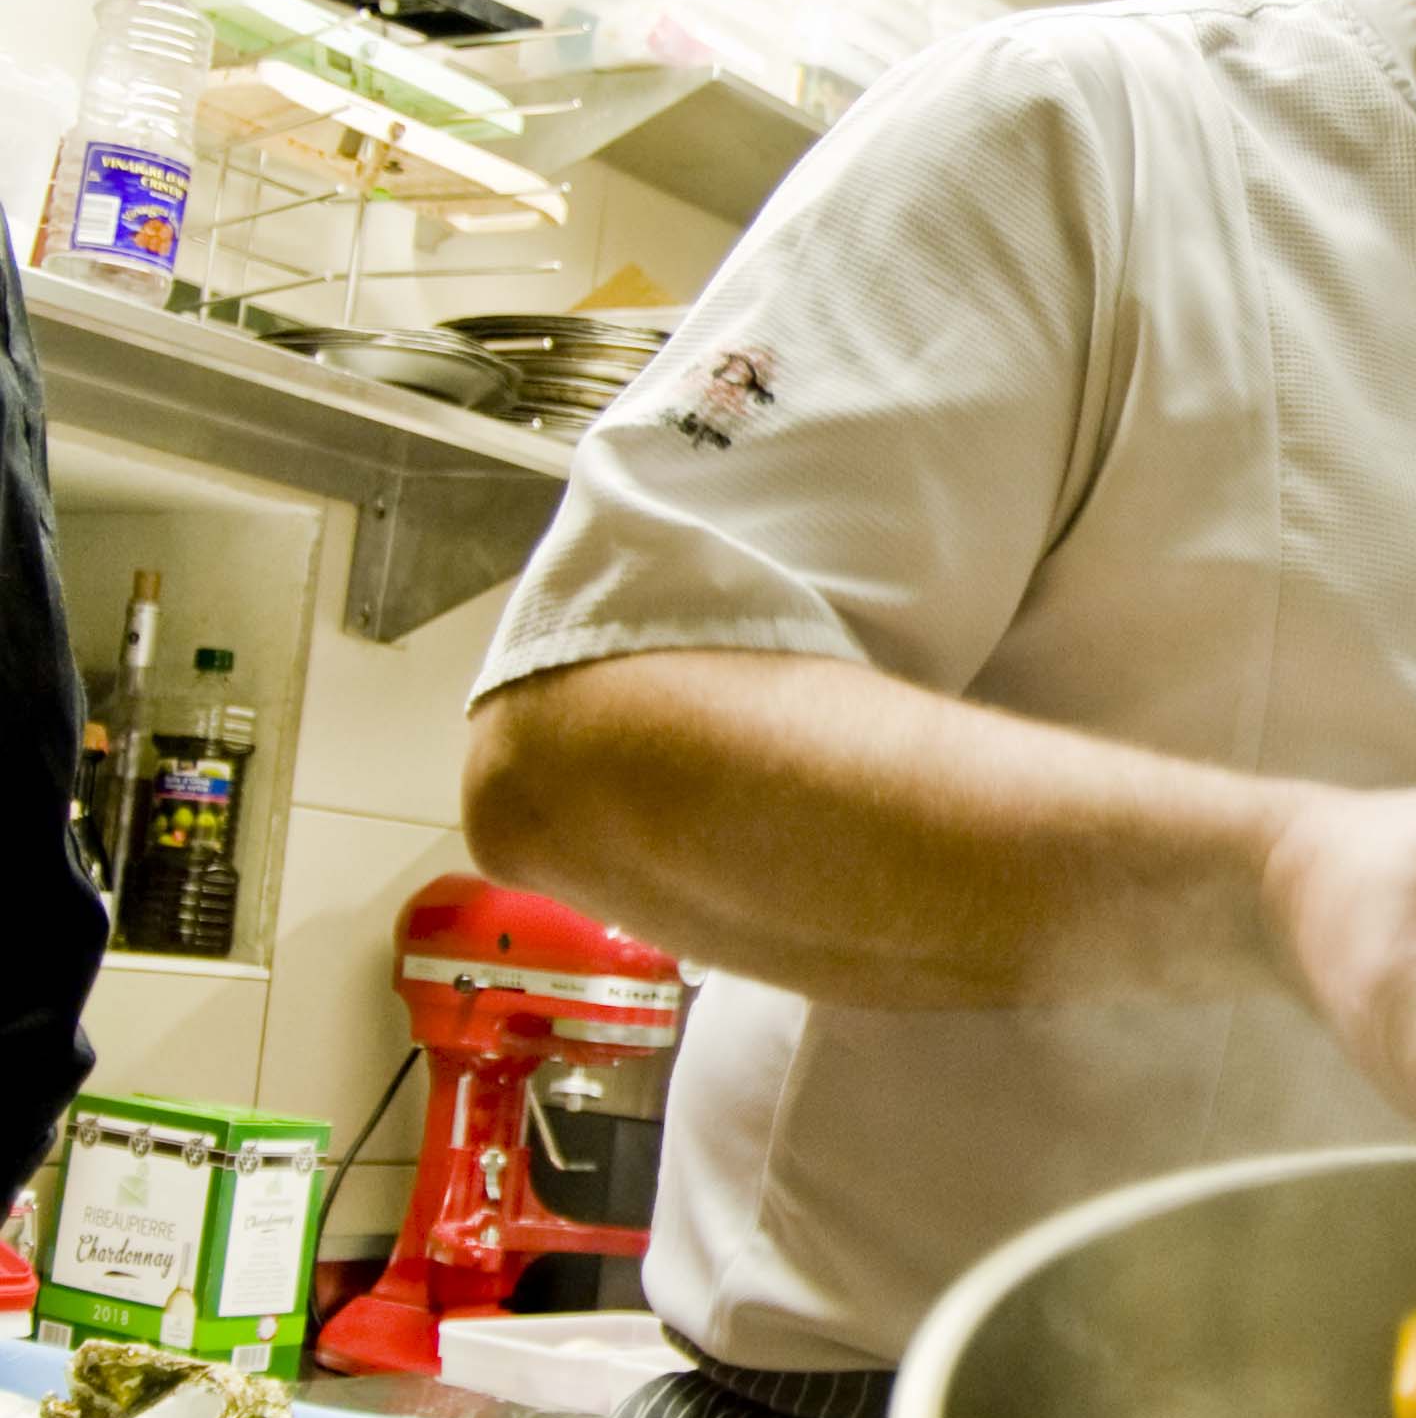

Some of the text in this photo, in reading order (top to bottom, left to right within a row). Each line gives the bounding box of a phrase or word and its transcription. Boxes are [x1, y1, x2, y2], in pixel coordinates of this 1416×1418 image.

[82, 1205, 177, 1242] RIBEAUPIERRE
[75, 1234, 175, 1279] Chardonnay
[93, 1303, 130, 1326] 2018
